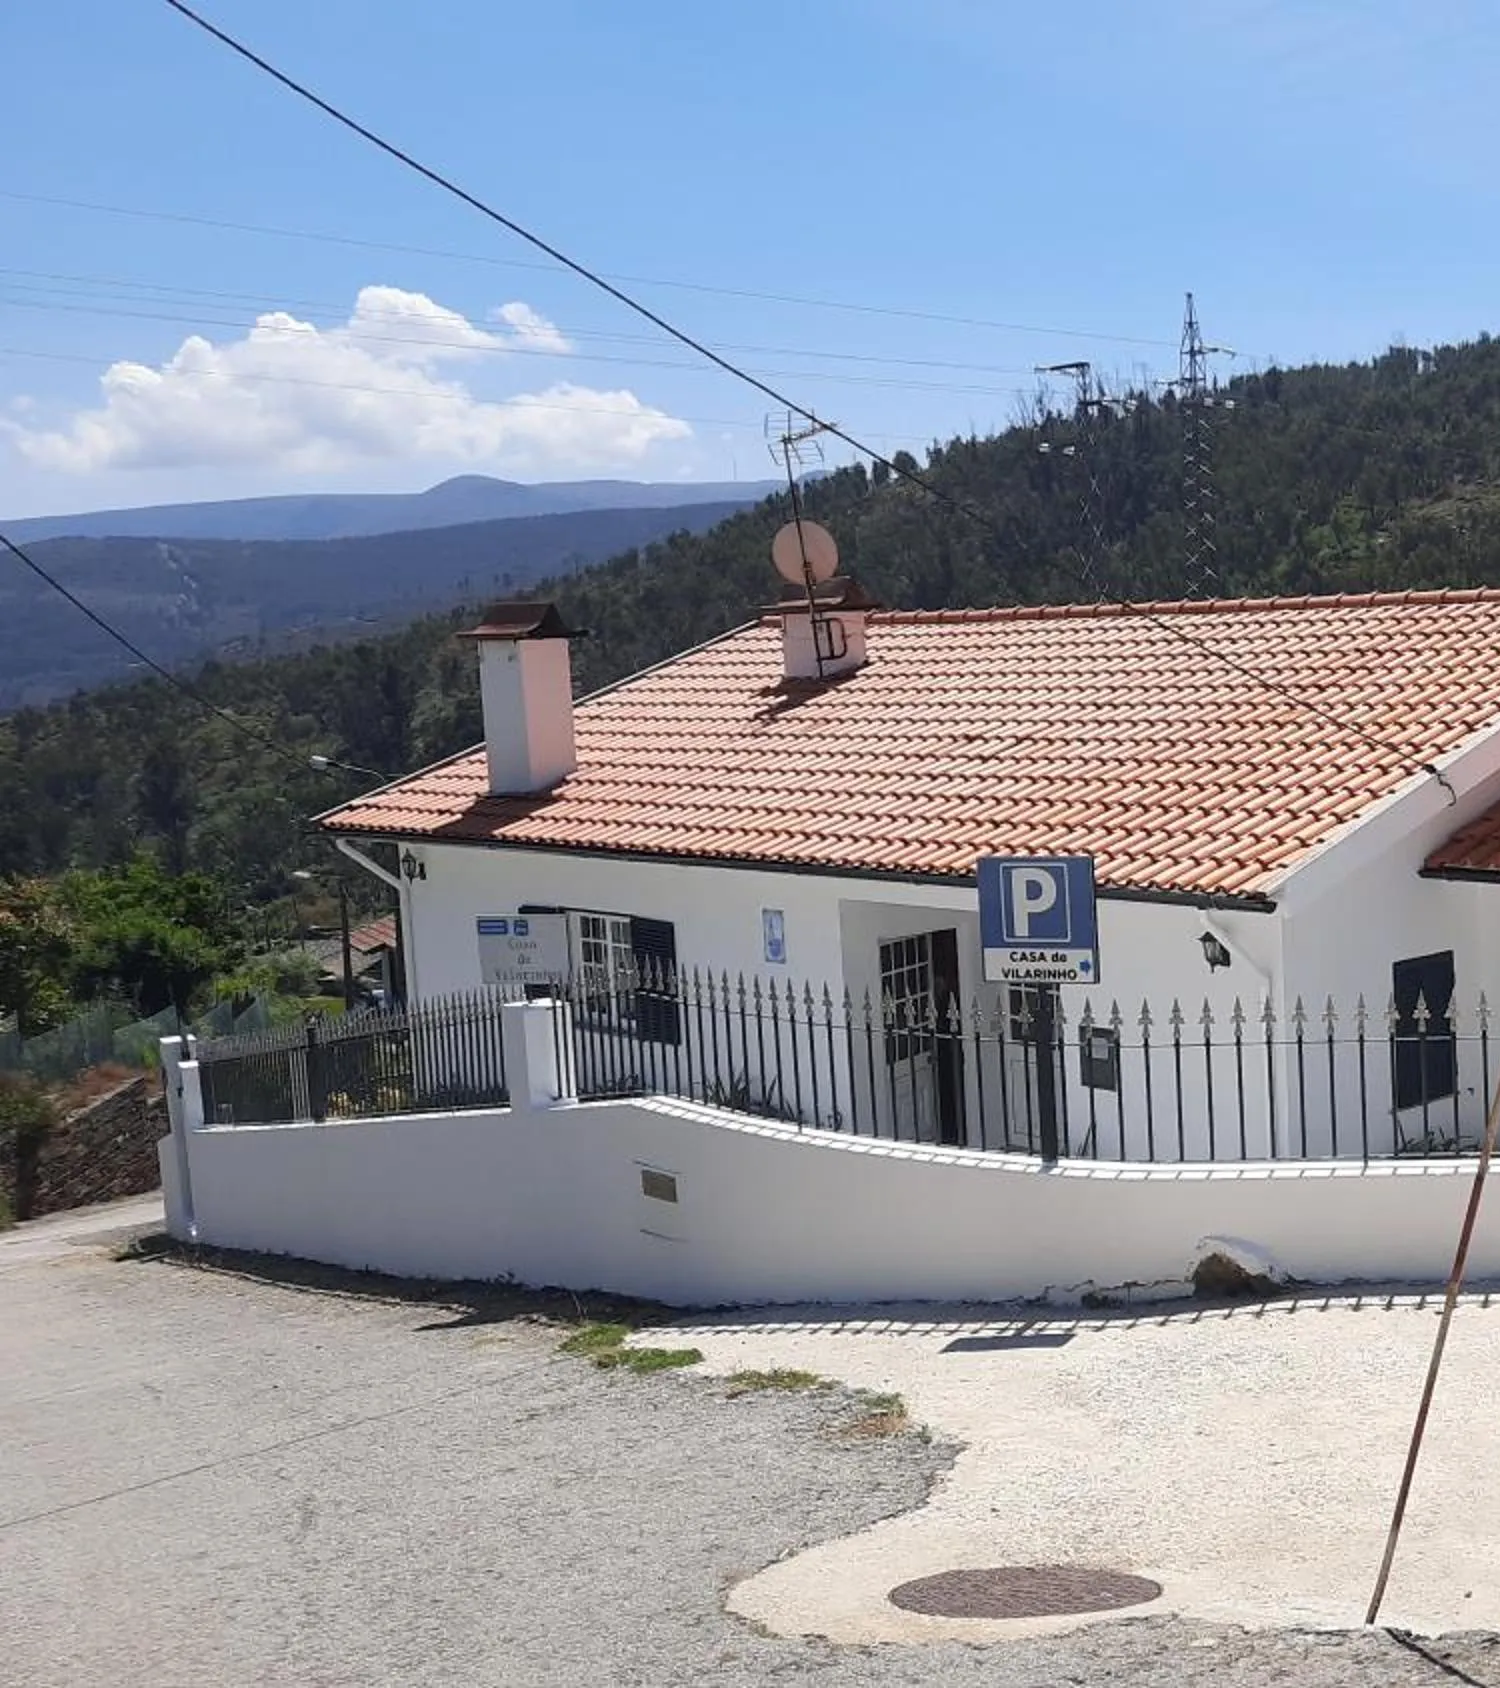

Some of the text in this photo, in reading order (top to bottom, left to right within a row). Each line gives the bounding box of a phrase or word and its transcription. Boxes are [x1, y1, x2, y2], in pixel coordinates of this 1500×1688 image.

[1011, 867, 1056, 937] P
[1009, 951, 1068, 963] CASA de
[1001, 967, 1077, 981] VILARINHO
